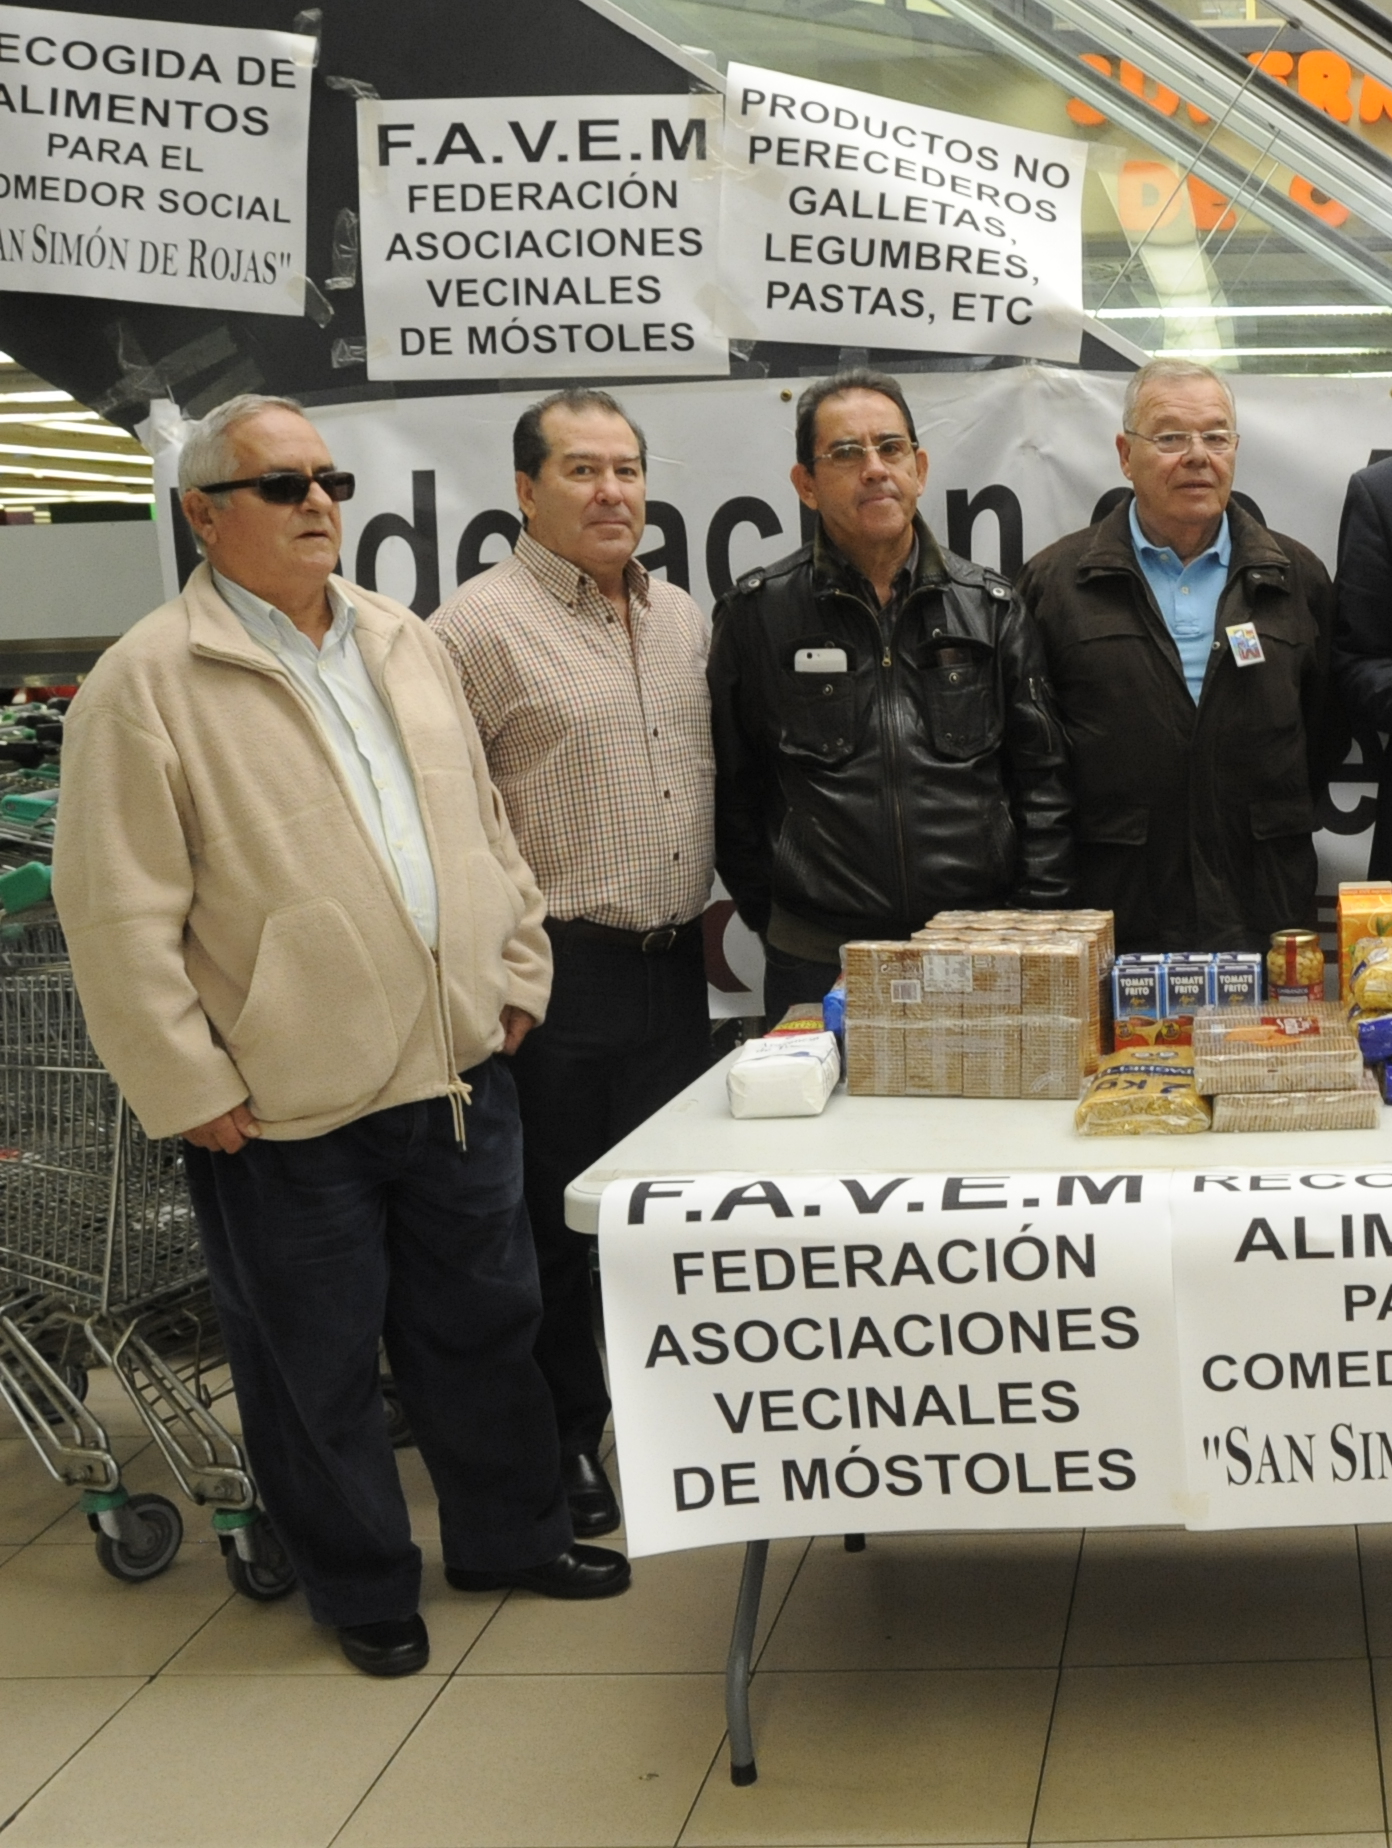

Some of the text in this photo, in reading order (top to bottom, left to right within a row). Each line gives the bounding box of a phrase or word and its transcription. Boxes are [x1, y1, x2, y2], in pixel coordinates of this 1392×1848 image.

[0, 32, 297, 89] ECOGIDA DE
[47, 132, 205, 173] PARA EL
[377, 118, 707, 167] F.A.V.E.M
[741, 88, 1071, 189] PRODUCTOS NO
[407, 172, 679, 214] FEDERACIÓN
[748, 135, 1058, 223] PERECEDEROS
[158, 188, 292, 224] SOCIAL
[788, 186, 1018, 246] GALLETAS,
[385, 227, 704, 262] ASOCIACIONES
[764, 233, 1041, 286] LEGUMBRES,
[426, 275, 661, 308] VECINALES
[766, 280, 1032, 326] PASTAS, ETC
[400, 316, 695, 356] DE MÓSTOLES
[1120, 978, 1154, 987] TOMATE
[1125, 986, 1150, 995] FRITO
[1170, 976, 1204, 986] TOMATE
[1175, 985, 1200, 994] FRITO
[1219, 975, 1253, 984] TOMATE
[1224, 983, 1248, 993] FRITO
[626, 1175, 1144, 1225] F.A.V.E.M
[673, 1224, 1096, 1295] FEDERACIÓN
[645, 1306, 1140, 1369] ASOCIACIONES
[713, 1380, 1081, 1434] VECINALES
[673, 1446, 1138, 1512] DE MÓSTOLES
